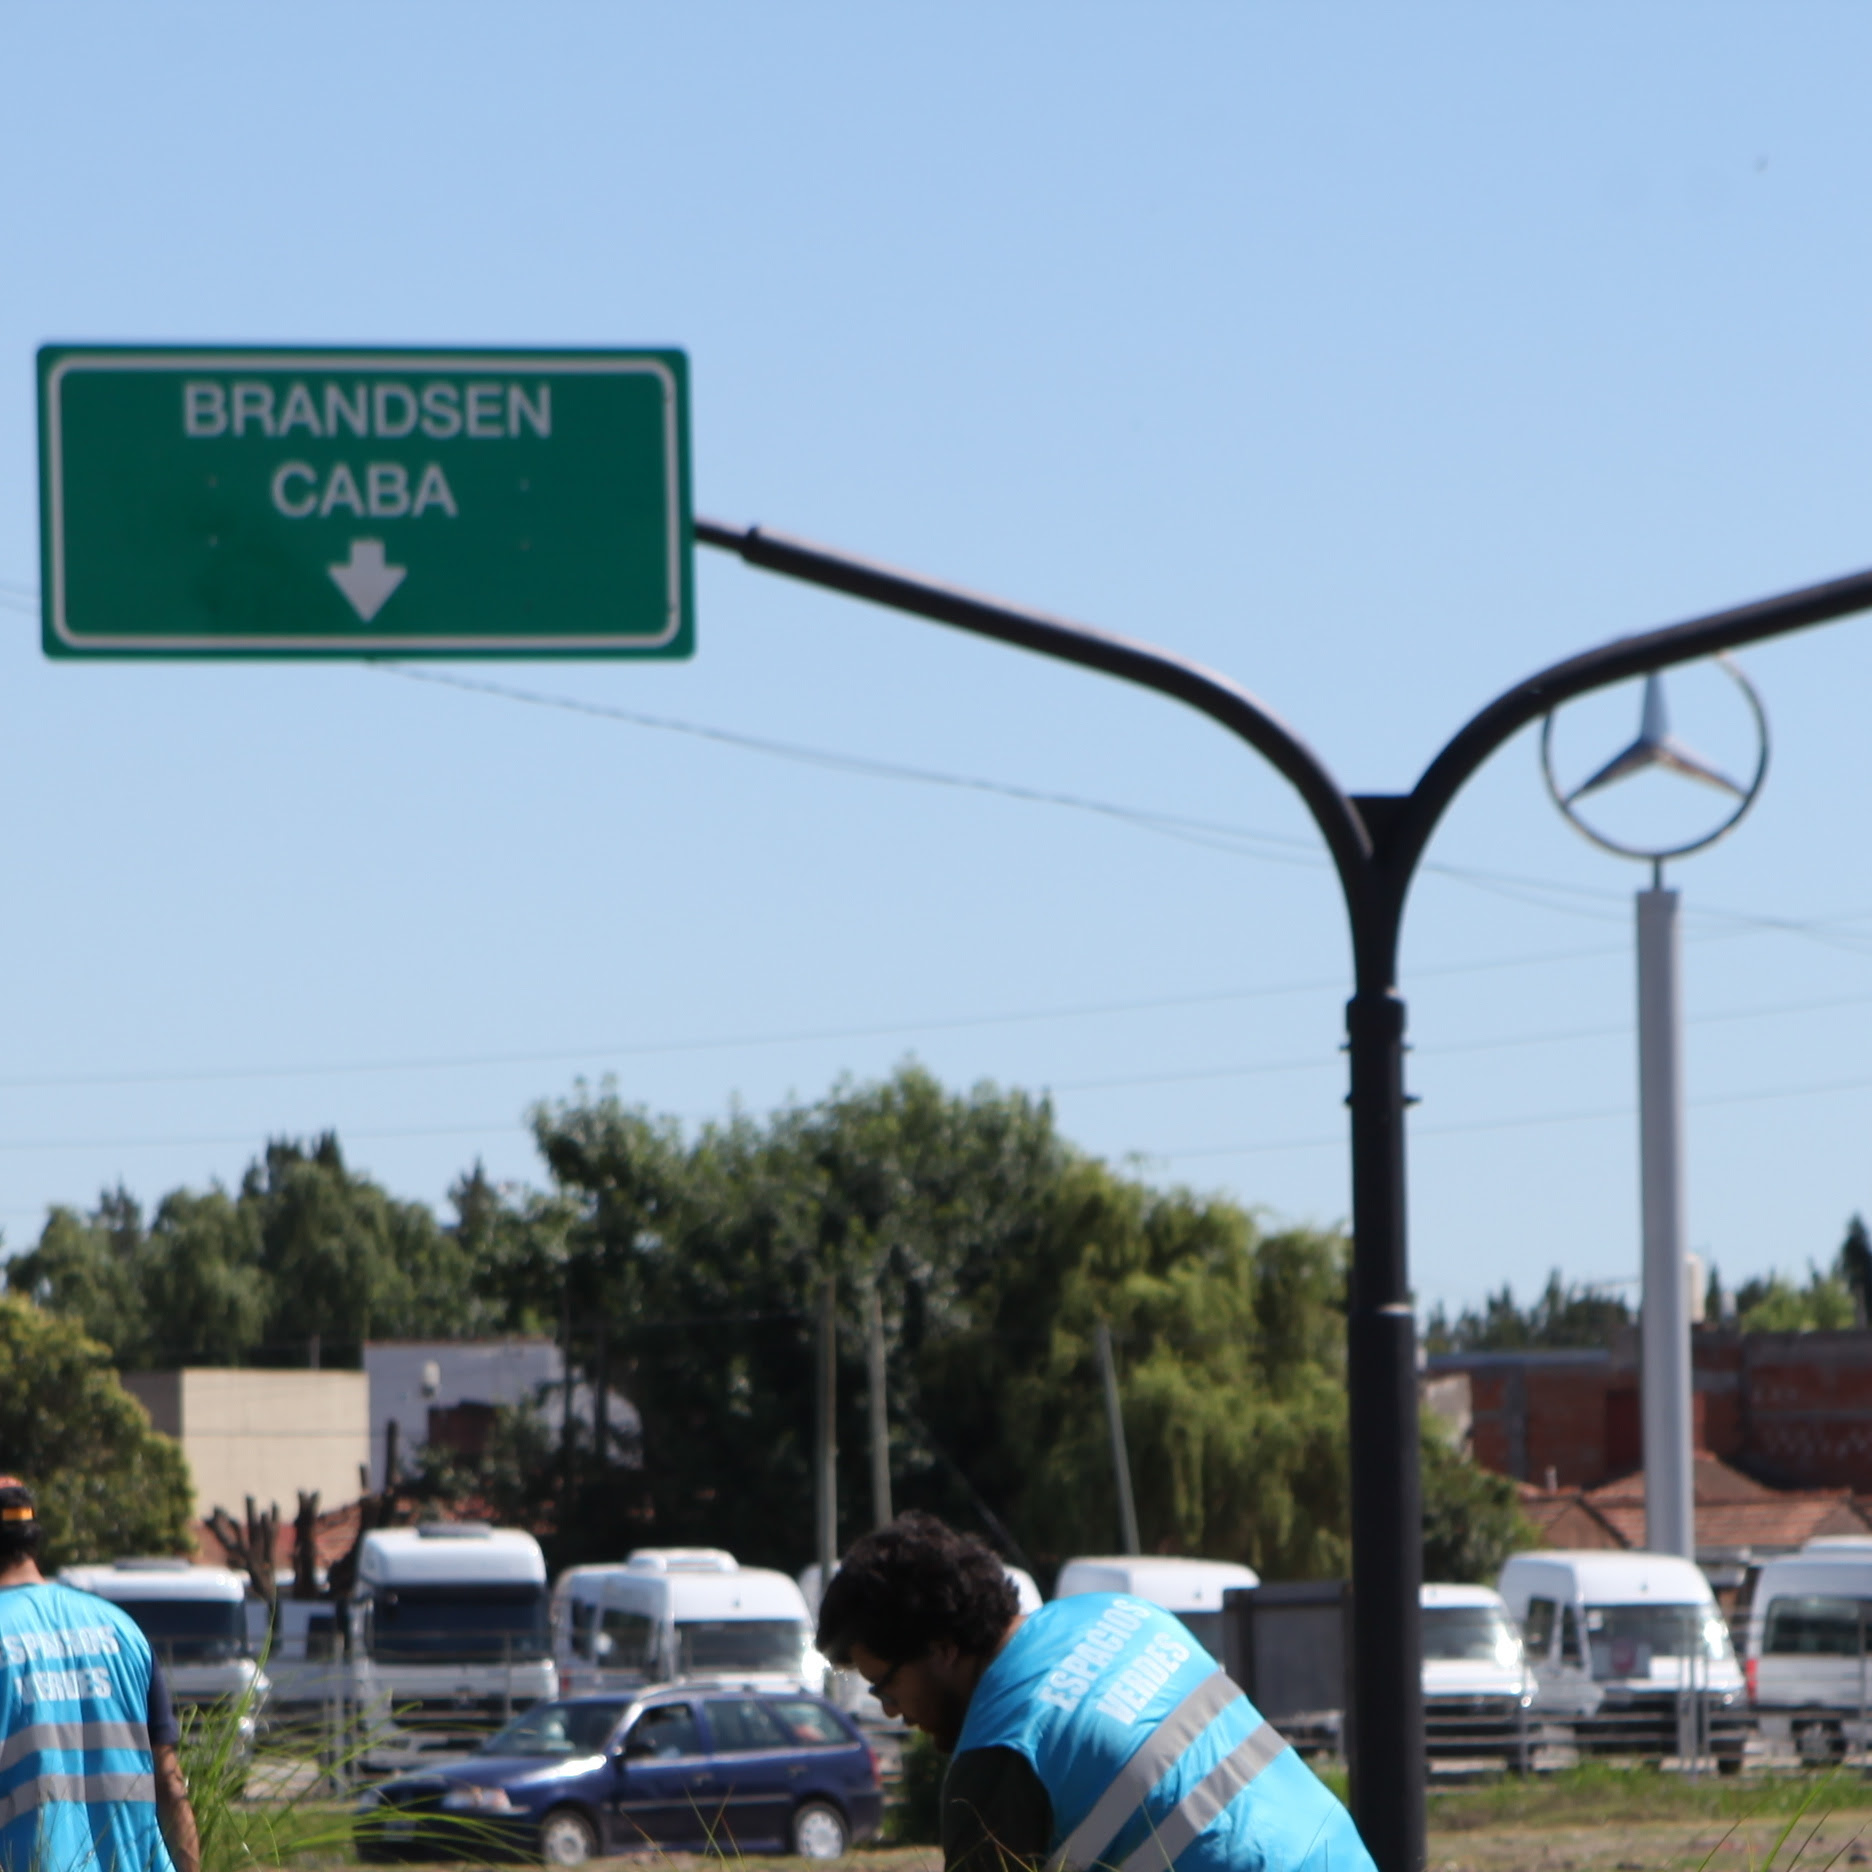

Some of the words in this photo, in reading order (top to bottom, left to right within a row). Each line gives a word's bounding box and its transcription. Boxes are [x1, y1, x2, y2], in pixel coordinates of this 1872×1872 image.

[183, 381, 552, 438] BRANDSEN
[271, 461, 459, 518] CABA
[1037, 1599, 1151, 1712] ESPACIOS
[1095, 1632, 1190, 1725] VERDES
